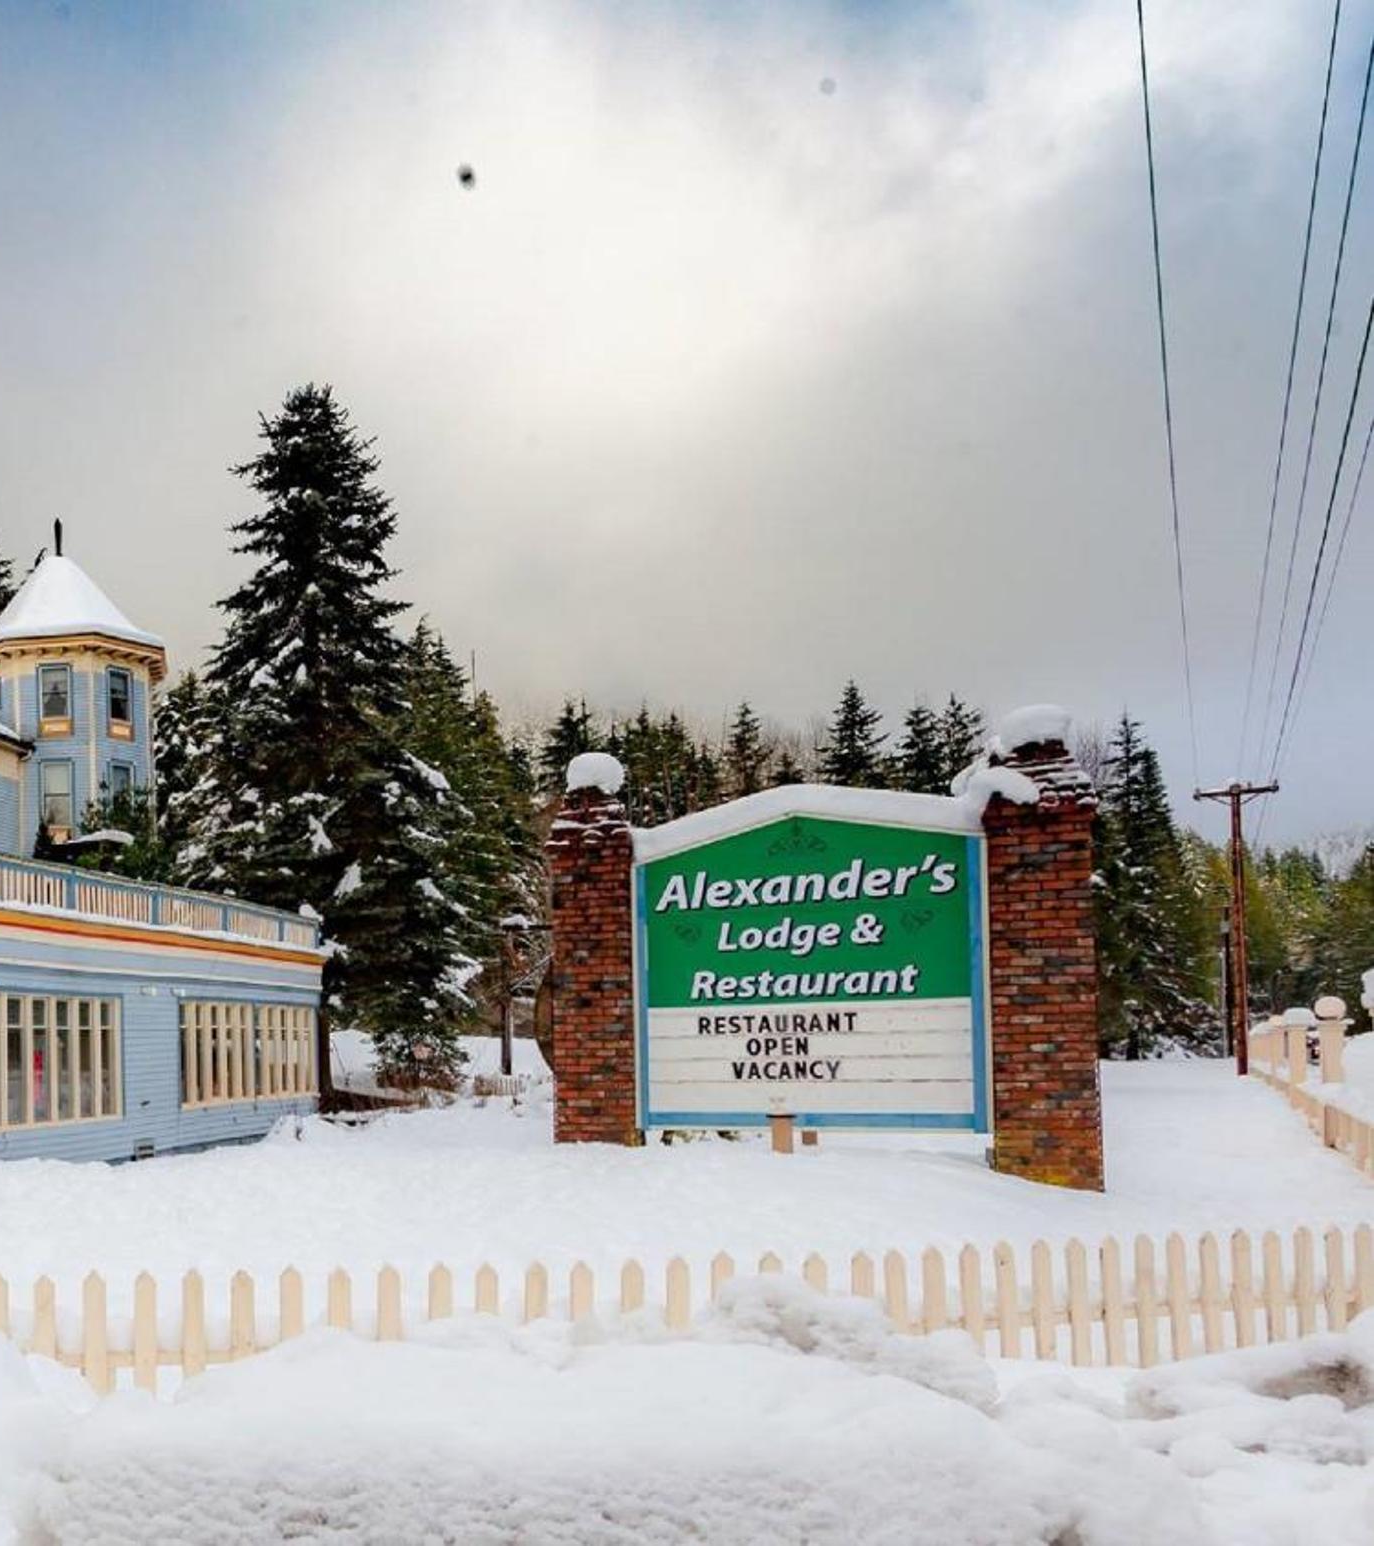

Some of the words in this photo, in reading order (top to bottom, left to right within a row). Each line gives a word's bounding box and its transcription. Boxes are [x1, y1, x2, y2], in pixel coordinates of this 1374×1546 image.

[655, 855, 956, 912] Alexander's
[717, 919, 840, 955] Lodge
[850, 914, 884, 944] &
[690, 964, 918, 1000] Restaurant
[698, 1012, 858, 1034] RESTAURANT
[746, 1037, 809, 1056] OPEN
[732, 1060, 840, 1080] VACANCY
